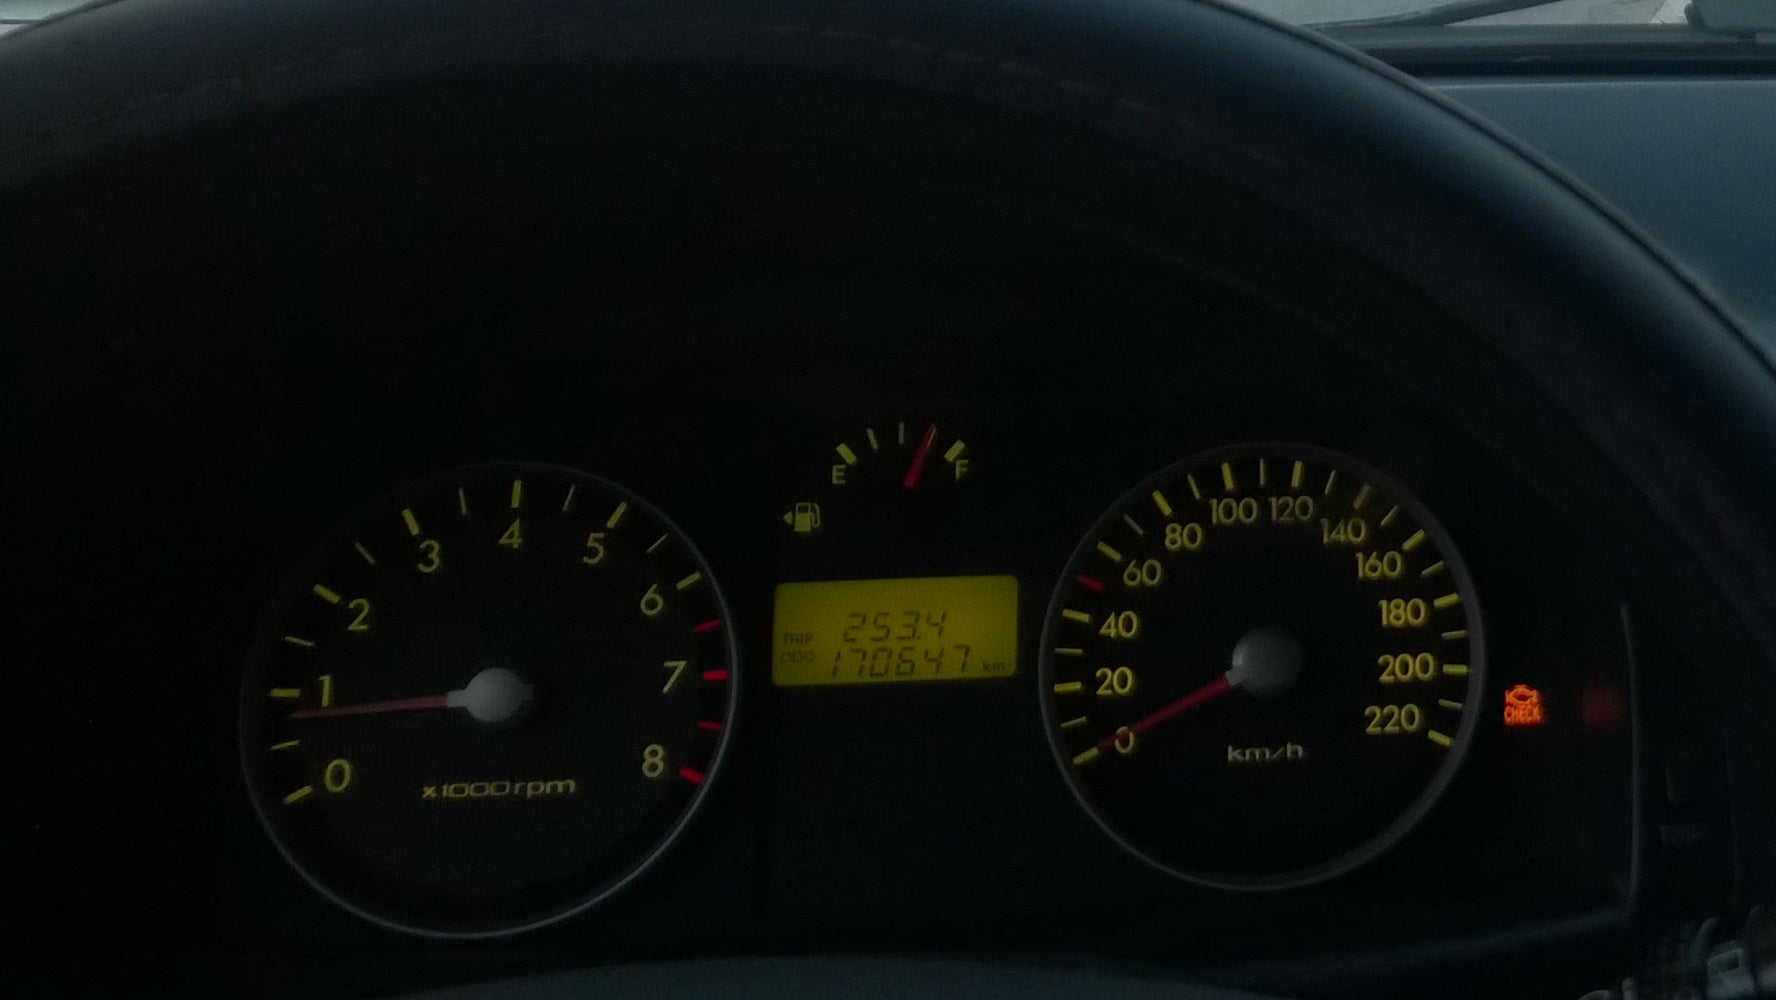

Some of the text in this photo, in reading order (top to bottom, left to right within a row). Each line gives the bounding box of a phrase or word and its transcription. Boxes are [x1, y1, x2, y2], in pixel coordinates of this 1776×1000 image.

[832, 464, 847, 485] E
[955, 459, 970, 482] F
[1209, 498, 1257, 524] 100
[1270, 496, 1314, 521] 120
[499, 519, 523, 549] 4
[1165, 522, 1203, 550] 80
[1321, 518, 1367, 545] 140
[418, 540, 441, 573] 3
[583, 533, 605, 565] 5
[1123, 559, 1162, 587] 60
[1356, 551, 1402, 579] 160
[641, 584, 664, 616] 6
[1379, 598, 1426, 627] 180
[347, 599, 370, 632] 2
[1100, 610, 1138, 638] 40
[663, 660, 687, 694] 7
[1096, 666, 1133, 695] 20
[1378, 652, 1435, 683] 200
[318, 675, 334, 708] 1
[1364, 703, 1422, 733] 220
[1115, 726, 1134, 753] 0
[1228, 743, 1304, 762] km/h
[642, 744, 665, 778] 8
[324, 758, 352, 794] 0
